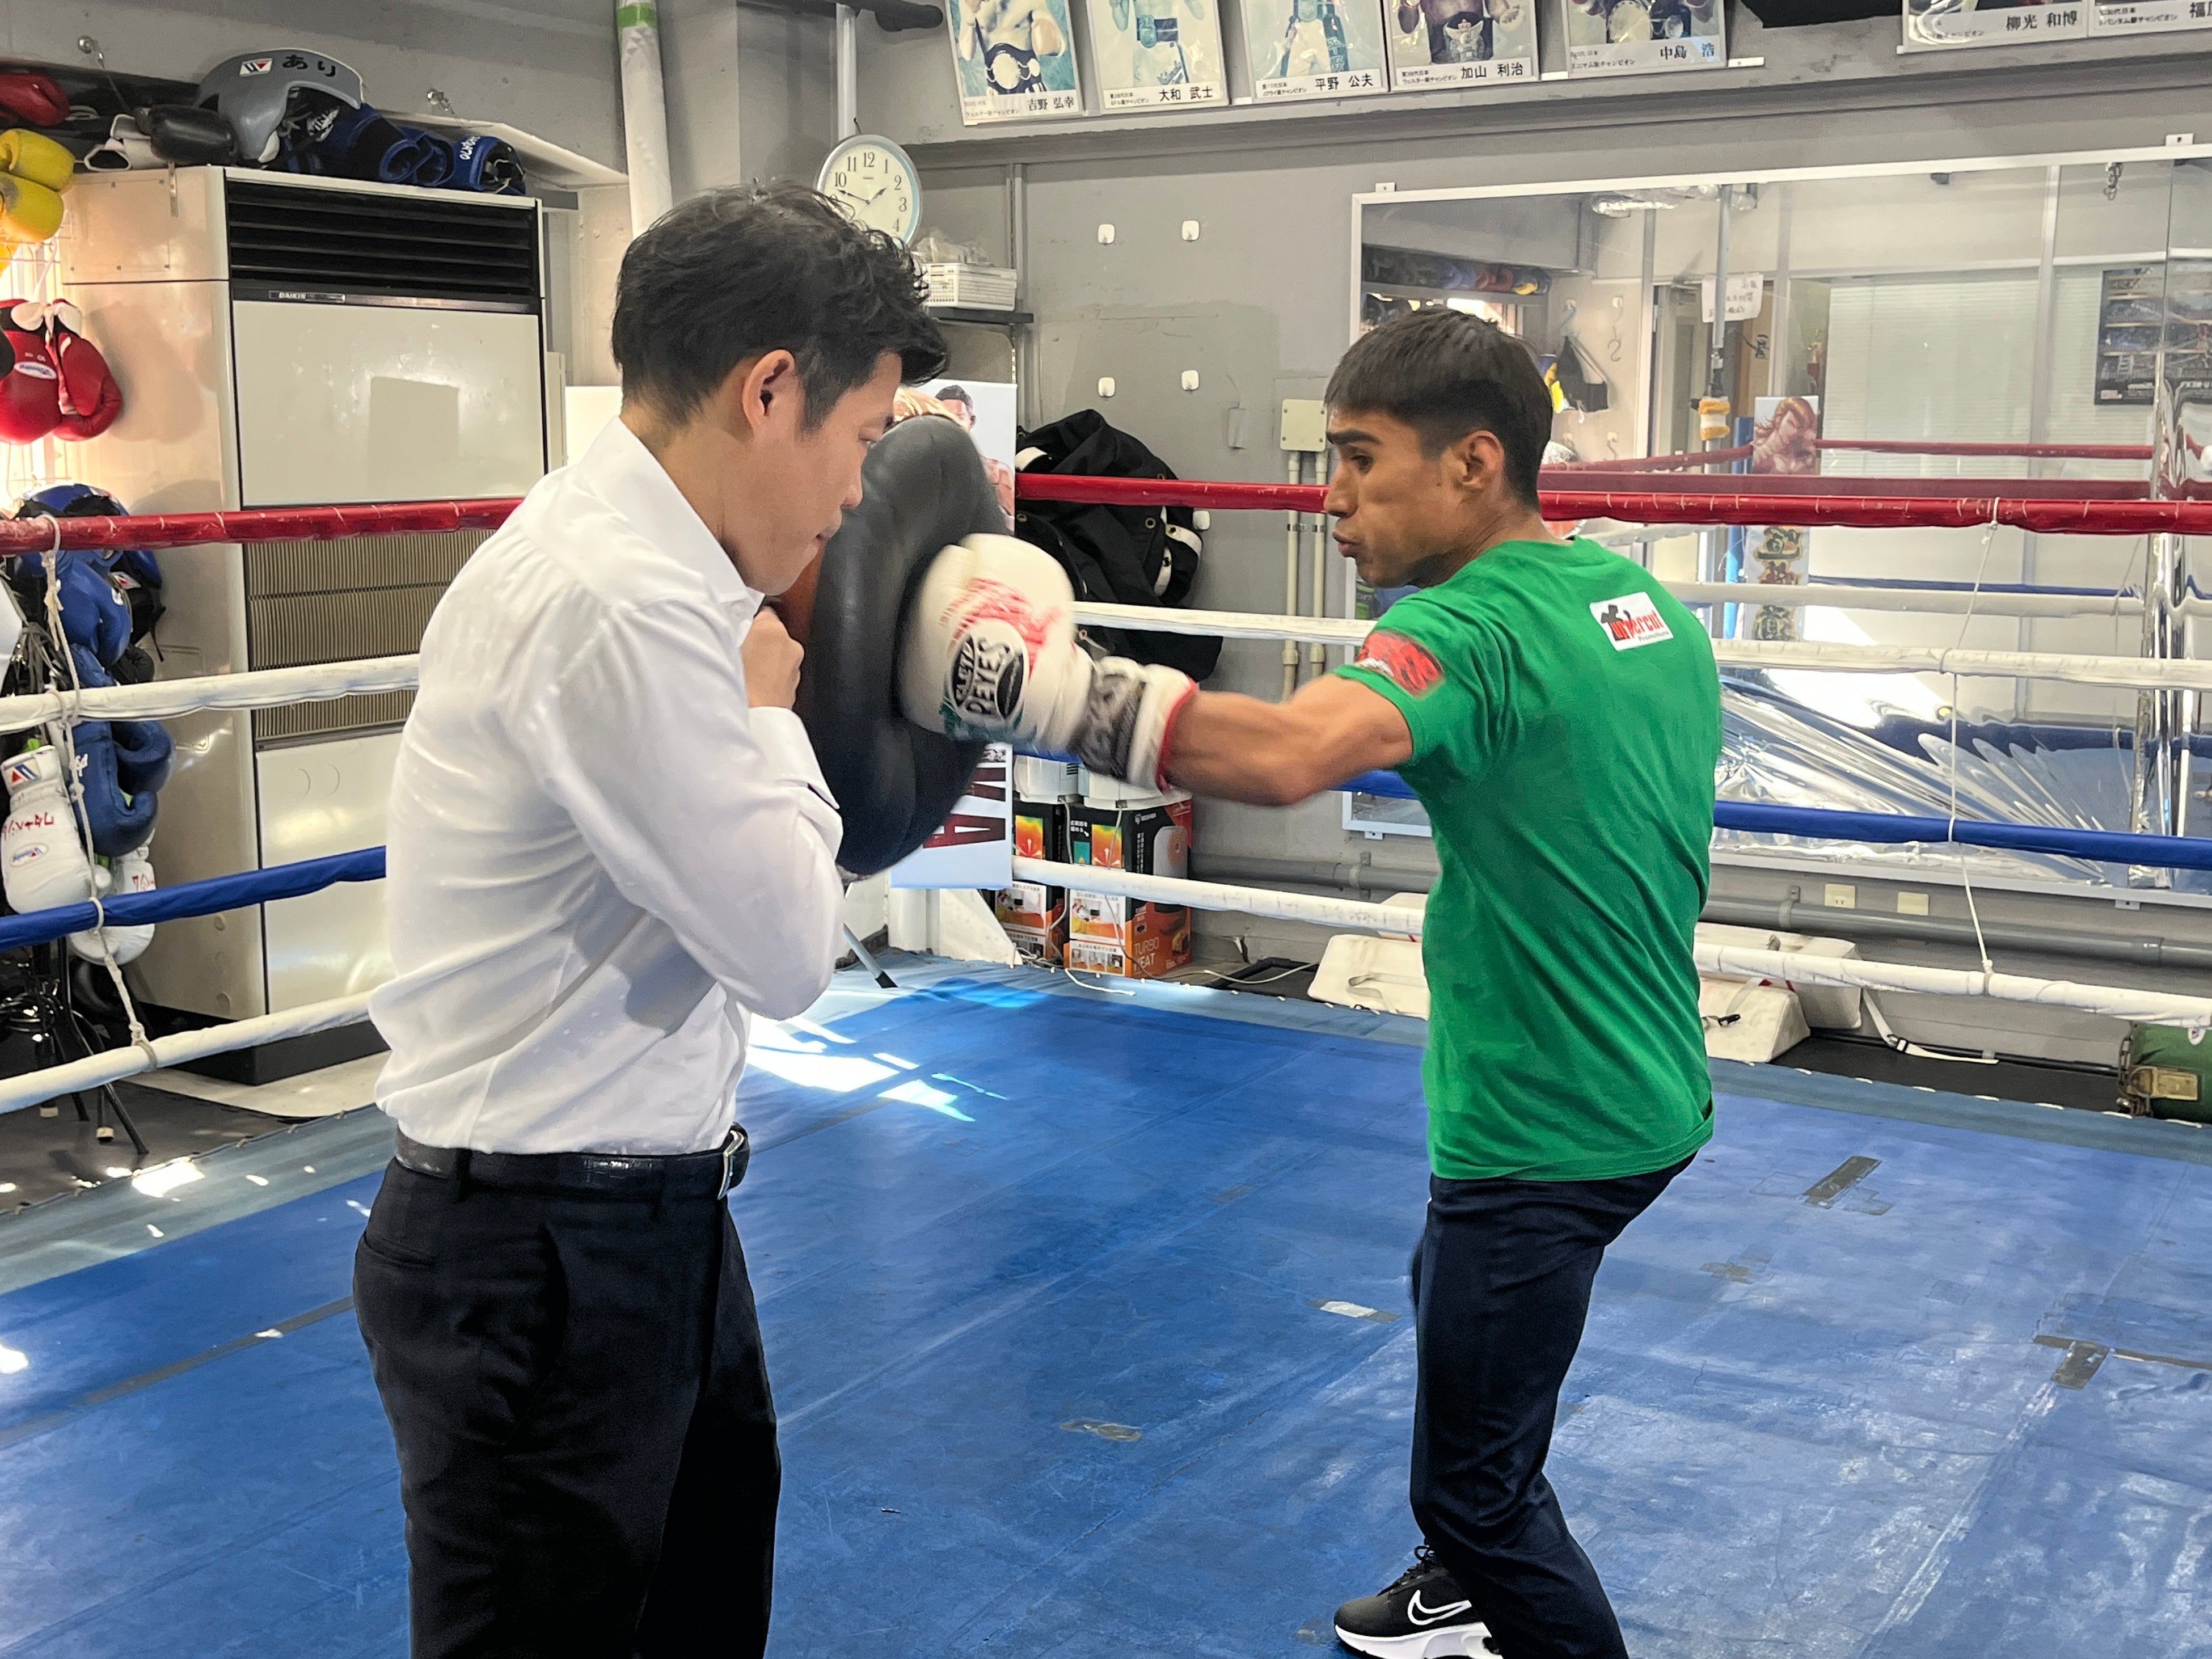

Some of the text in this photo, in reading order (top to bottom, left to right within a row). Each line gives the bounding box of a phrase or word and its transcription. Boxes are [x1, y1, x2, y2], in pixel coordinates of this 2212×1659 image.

[2190, 2, 2212, 19] 福
[282, 54, 336, 77] あり
[1460, 62, 1523, 79] 加山 利治
[1315, 73, 1373, 91] 平野 公夫
[1159, 86, 1213, 102] 大和 武士
[1029, 98, 1048, 111] 吉野
[847, 156, 856, 172] 11
[863, 152, 875, 167] 12
[885, 158, 889, 174] 1
[834, 171, 847, 188] 10
[894, 175, 902, 191] 2
[899, 197, 907, 212] 3
[892, 218, 900, 233] 4
[1134, 937, 1159, 956] TURBO
